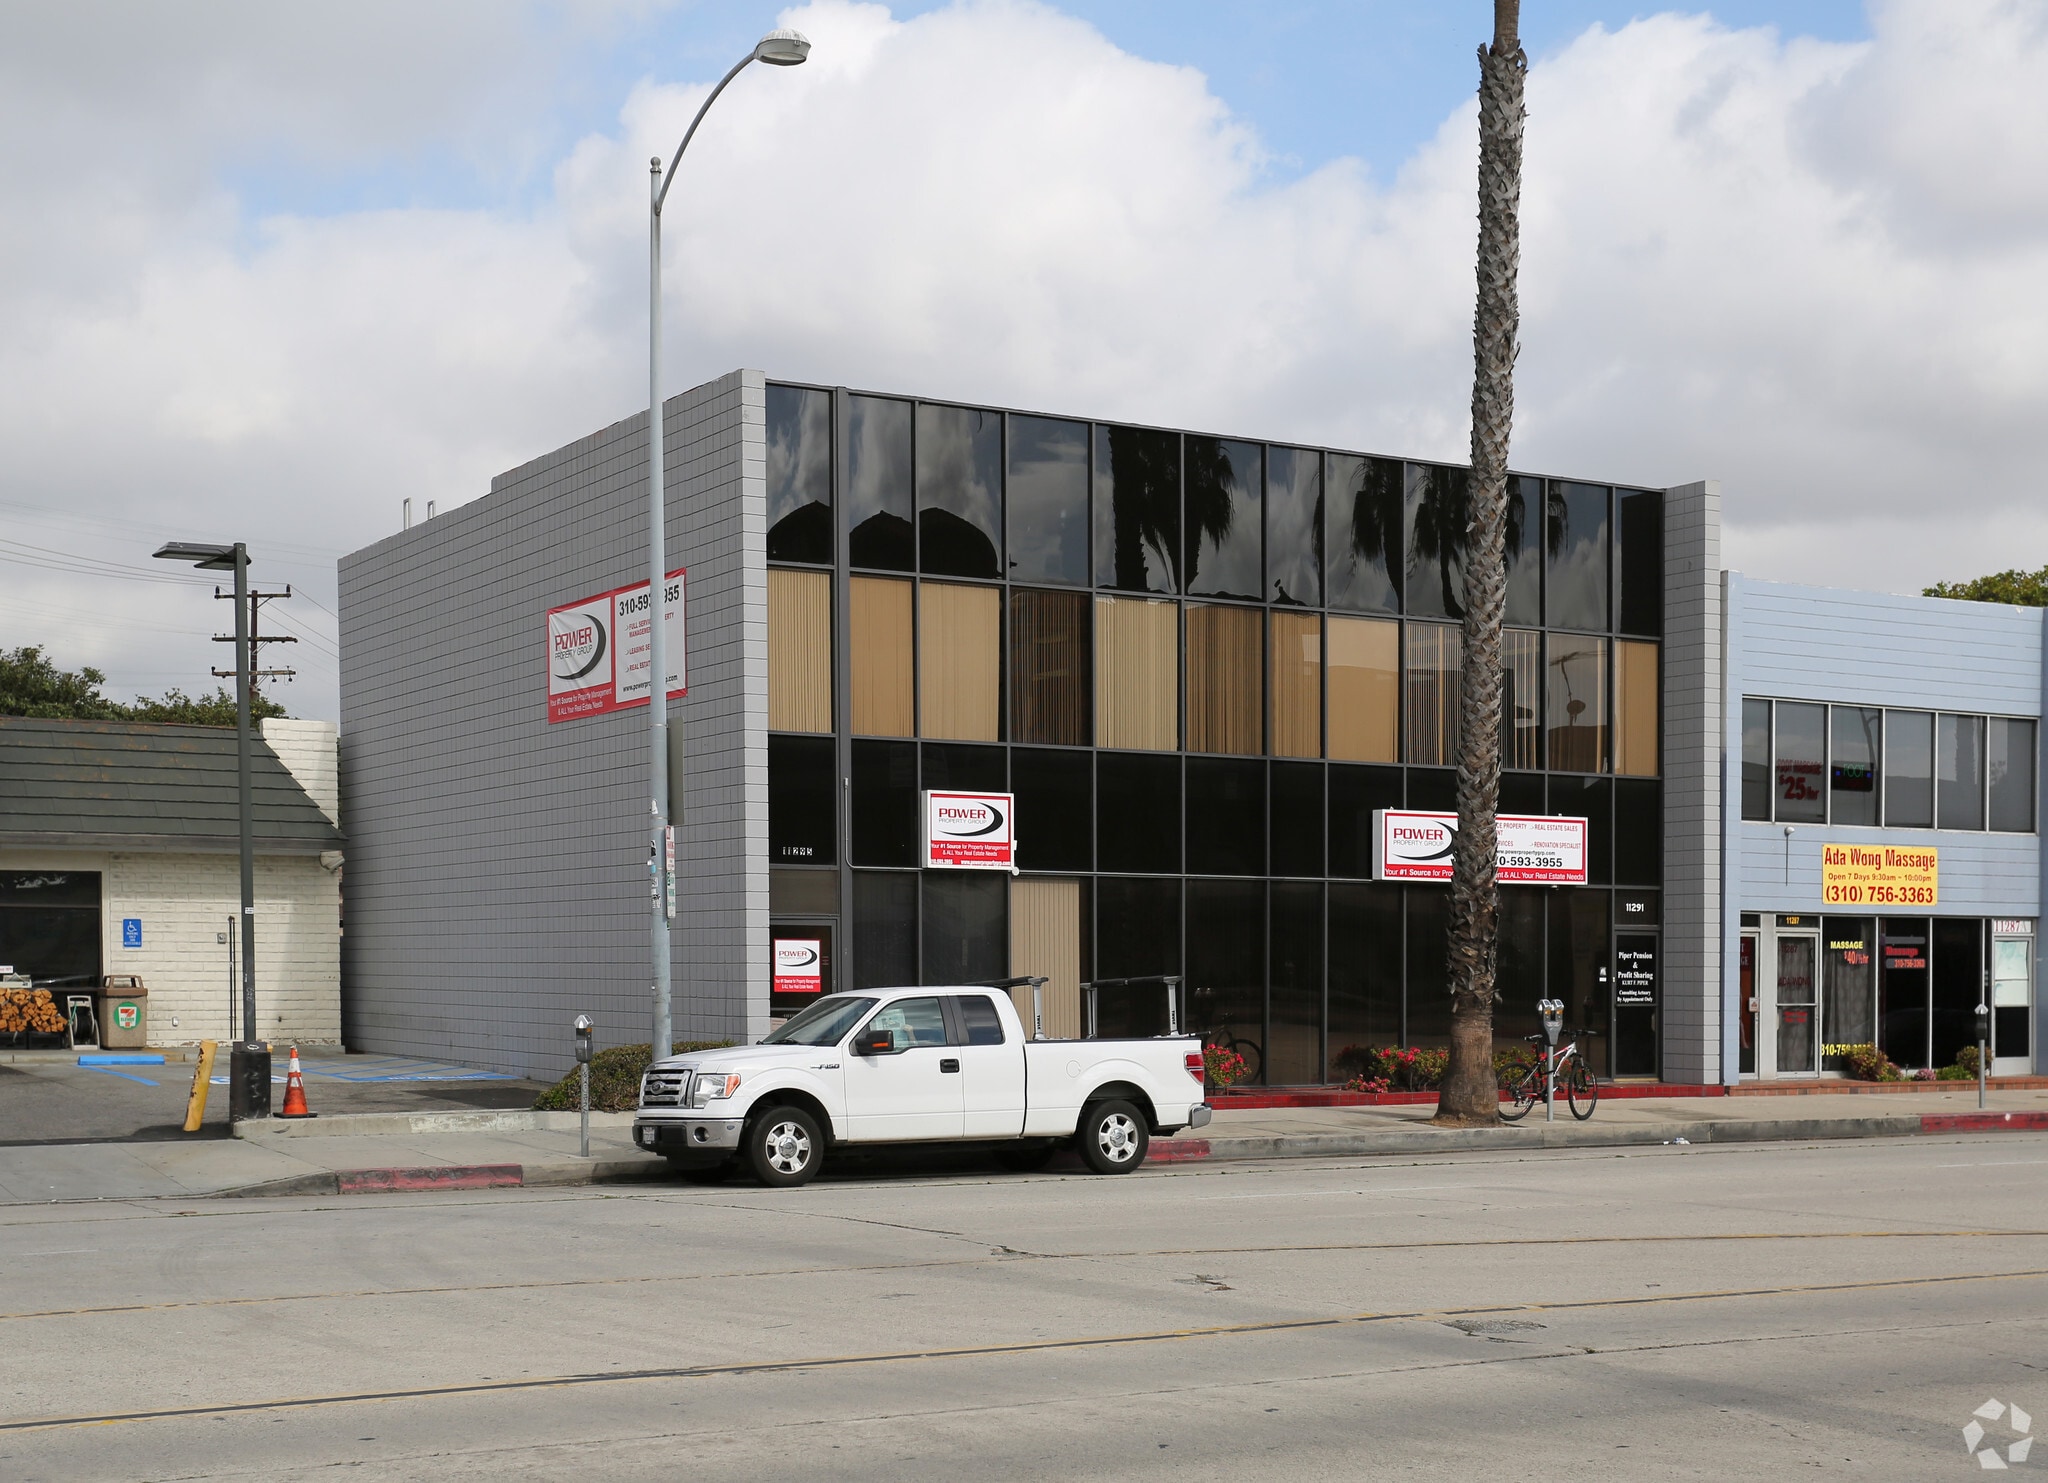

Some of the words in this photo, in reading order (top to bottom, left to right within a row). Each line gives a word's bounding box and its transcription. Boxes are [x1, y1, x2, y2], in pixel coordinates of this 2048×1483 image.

[555, 627, 592, 651] POWER
[555, 649, 576, 661] PROPERTY
[577, 645, 593, 656] GROUP
[1843, 763, 1865, 778] FOOT
[939, 808, 986, 819] POWER
[1393, 828, 1443, 840] POWER
[968, 844, 984, 852] Property
[1534, 841, 1558, 849] RENOVATION
[782, 847, 813, 856] 11295
[1824, 847, 1846, 866] Ada
[1850, 848, 1881, 871] Wong
[1885, 849, 1935, 871] Massage
[1385, 868, 1399, 876] Your
[1400, 868, 1408, 876] #1
[1409, 868, 1431, 877] Source
[1432, 869, 1441, 877] for
[1510, 871, 1521, 879] ALL
[1521, 871, 1535, 879] Your
[1535, 872, 1548, 880] Real
[1828, 872, 1846, 881] Open
[1848, 872, 1852, 880] 7
[1853, 873, 1870, 882] Days
[1871, 873, 1896, 881] 9:30am
[1904, 874, 1932, 882] 10:00pm
[1826, 885, 1863, 902] (310)
[1867, 886, 1933, 903] 756-3363
[1625, 903, 1644, 912] 11291
[1830, 940, 1863, 949] MASSAGE
[1618, 951, 1632, 960] Piper
[1633, 951, 1653, 959] Pension
[1632, 961, 1638, 969] &
[1617, 971, 1632, 979] Profit
[1633, 971, 1653, 980] Sharing
